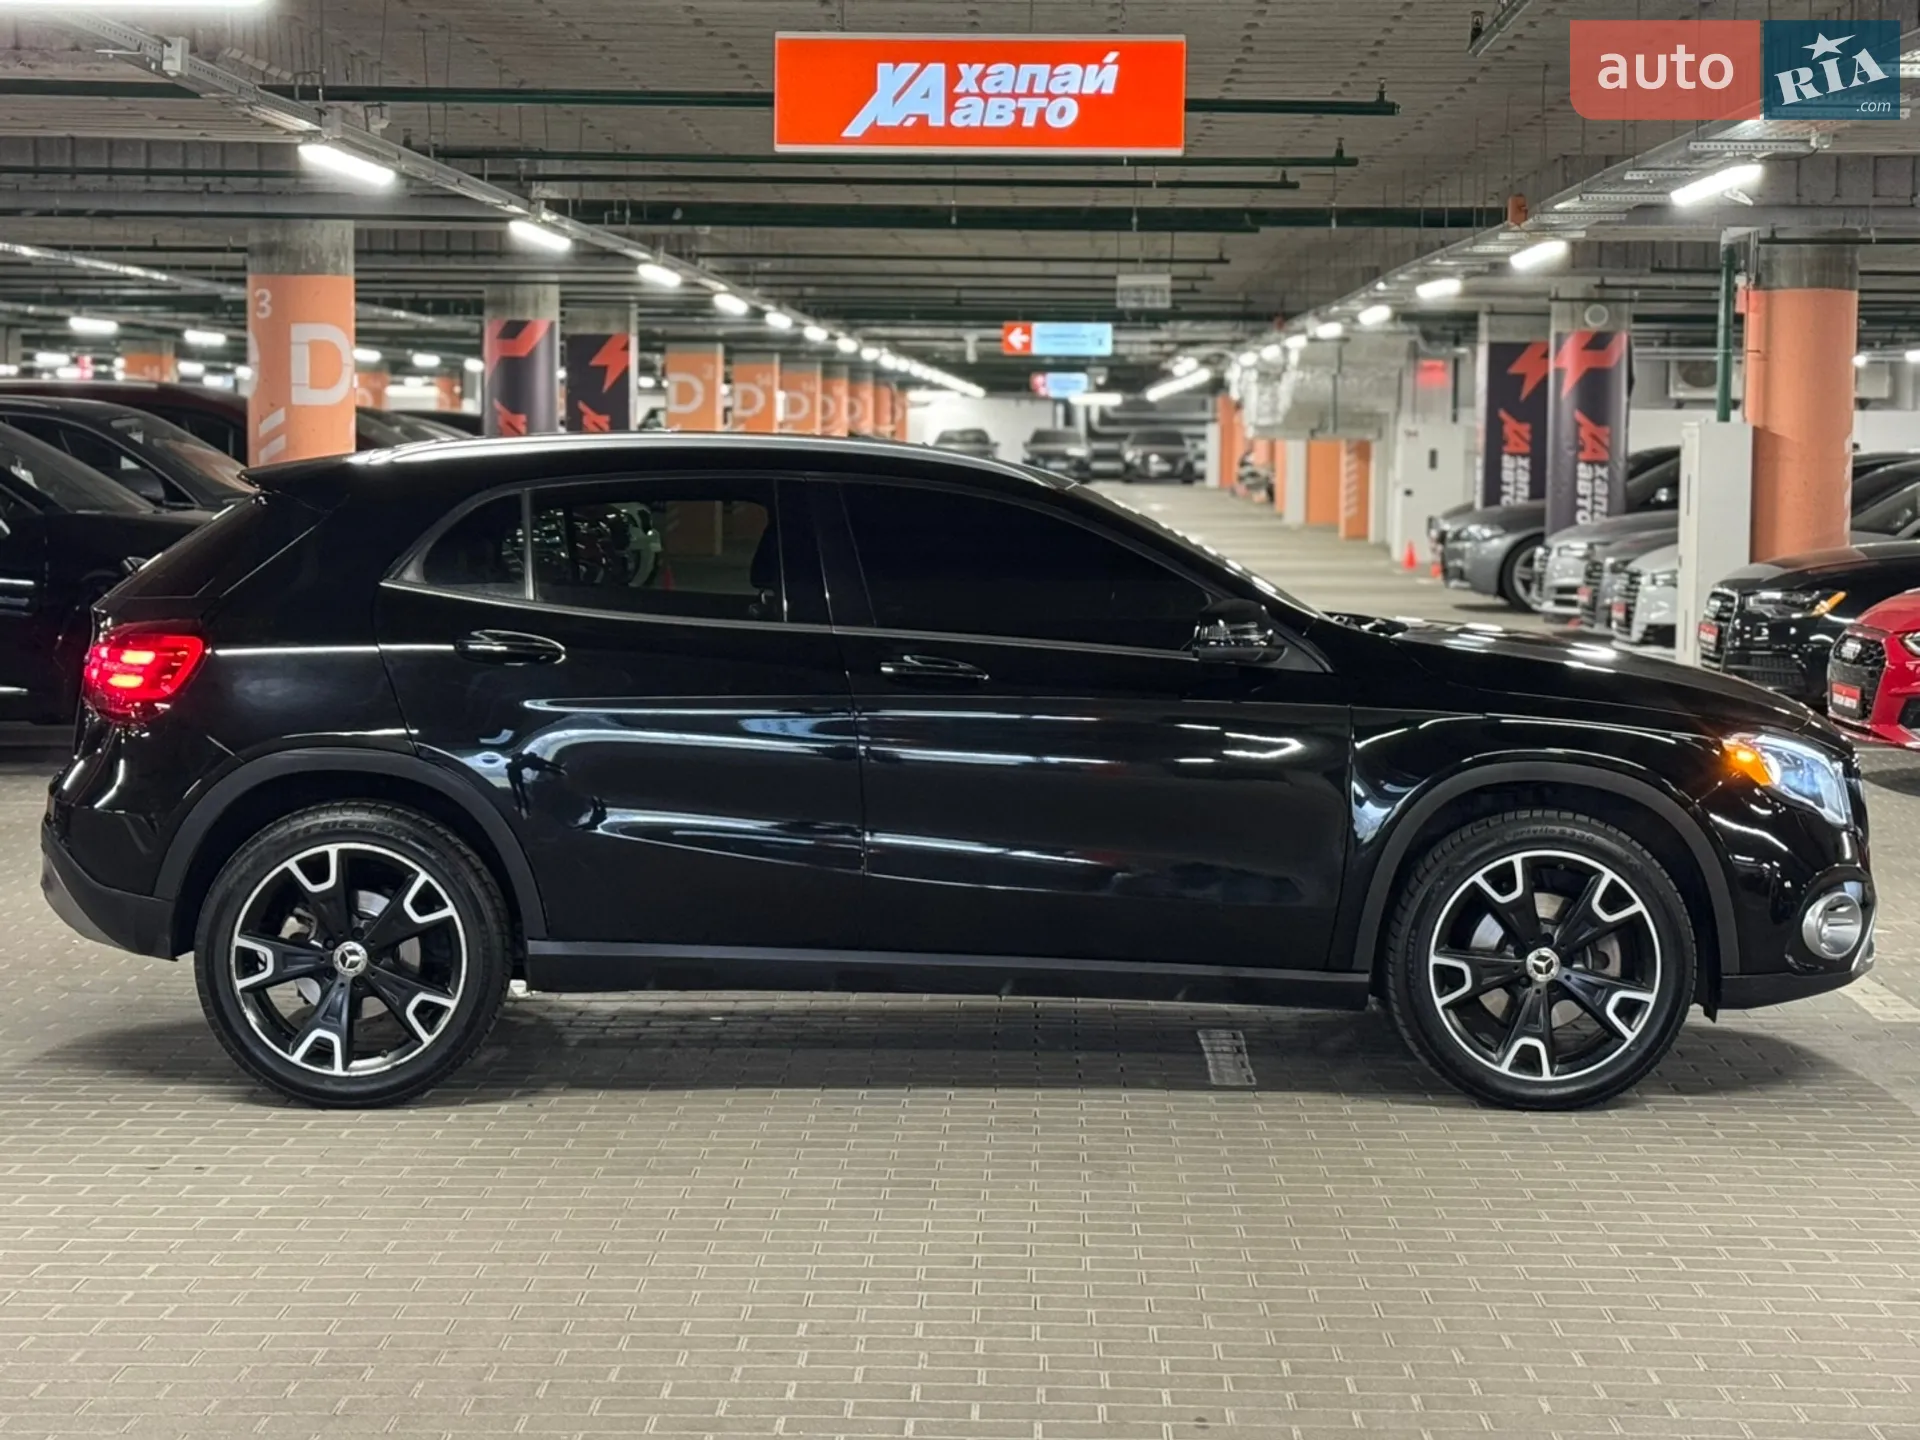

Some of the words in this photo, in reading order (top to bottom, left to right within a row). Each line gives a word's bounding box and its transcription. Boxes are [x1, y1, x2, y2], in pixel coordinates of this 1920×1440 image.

[952, 50, 1120, 95] хапай
[949, 96, 1079, 128] авто
[254, 287, 273, 320] 3
[290, 322, 354, 406] D
[667, 372, 704, 414] D
[734, 382, 766, 418] D
[783, 389, 811, 421] D
